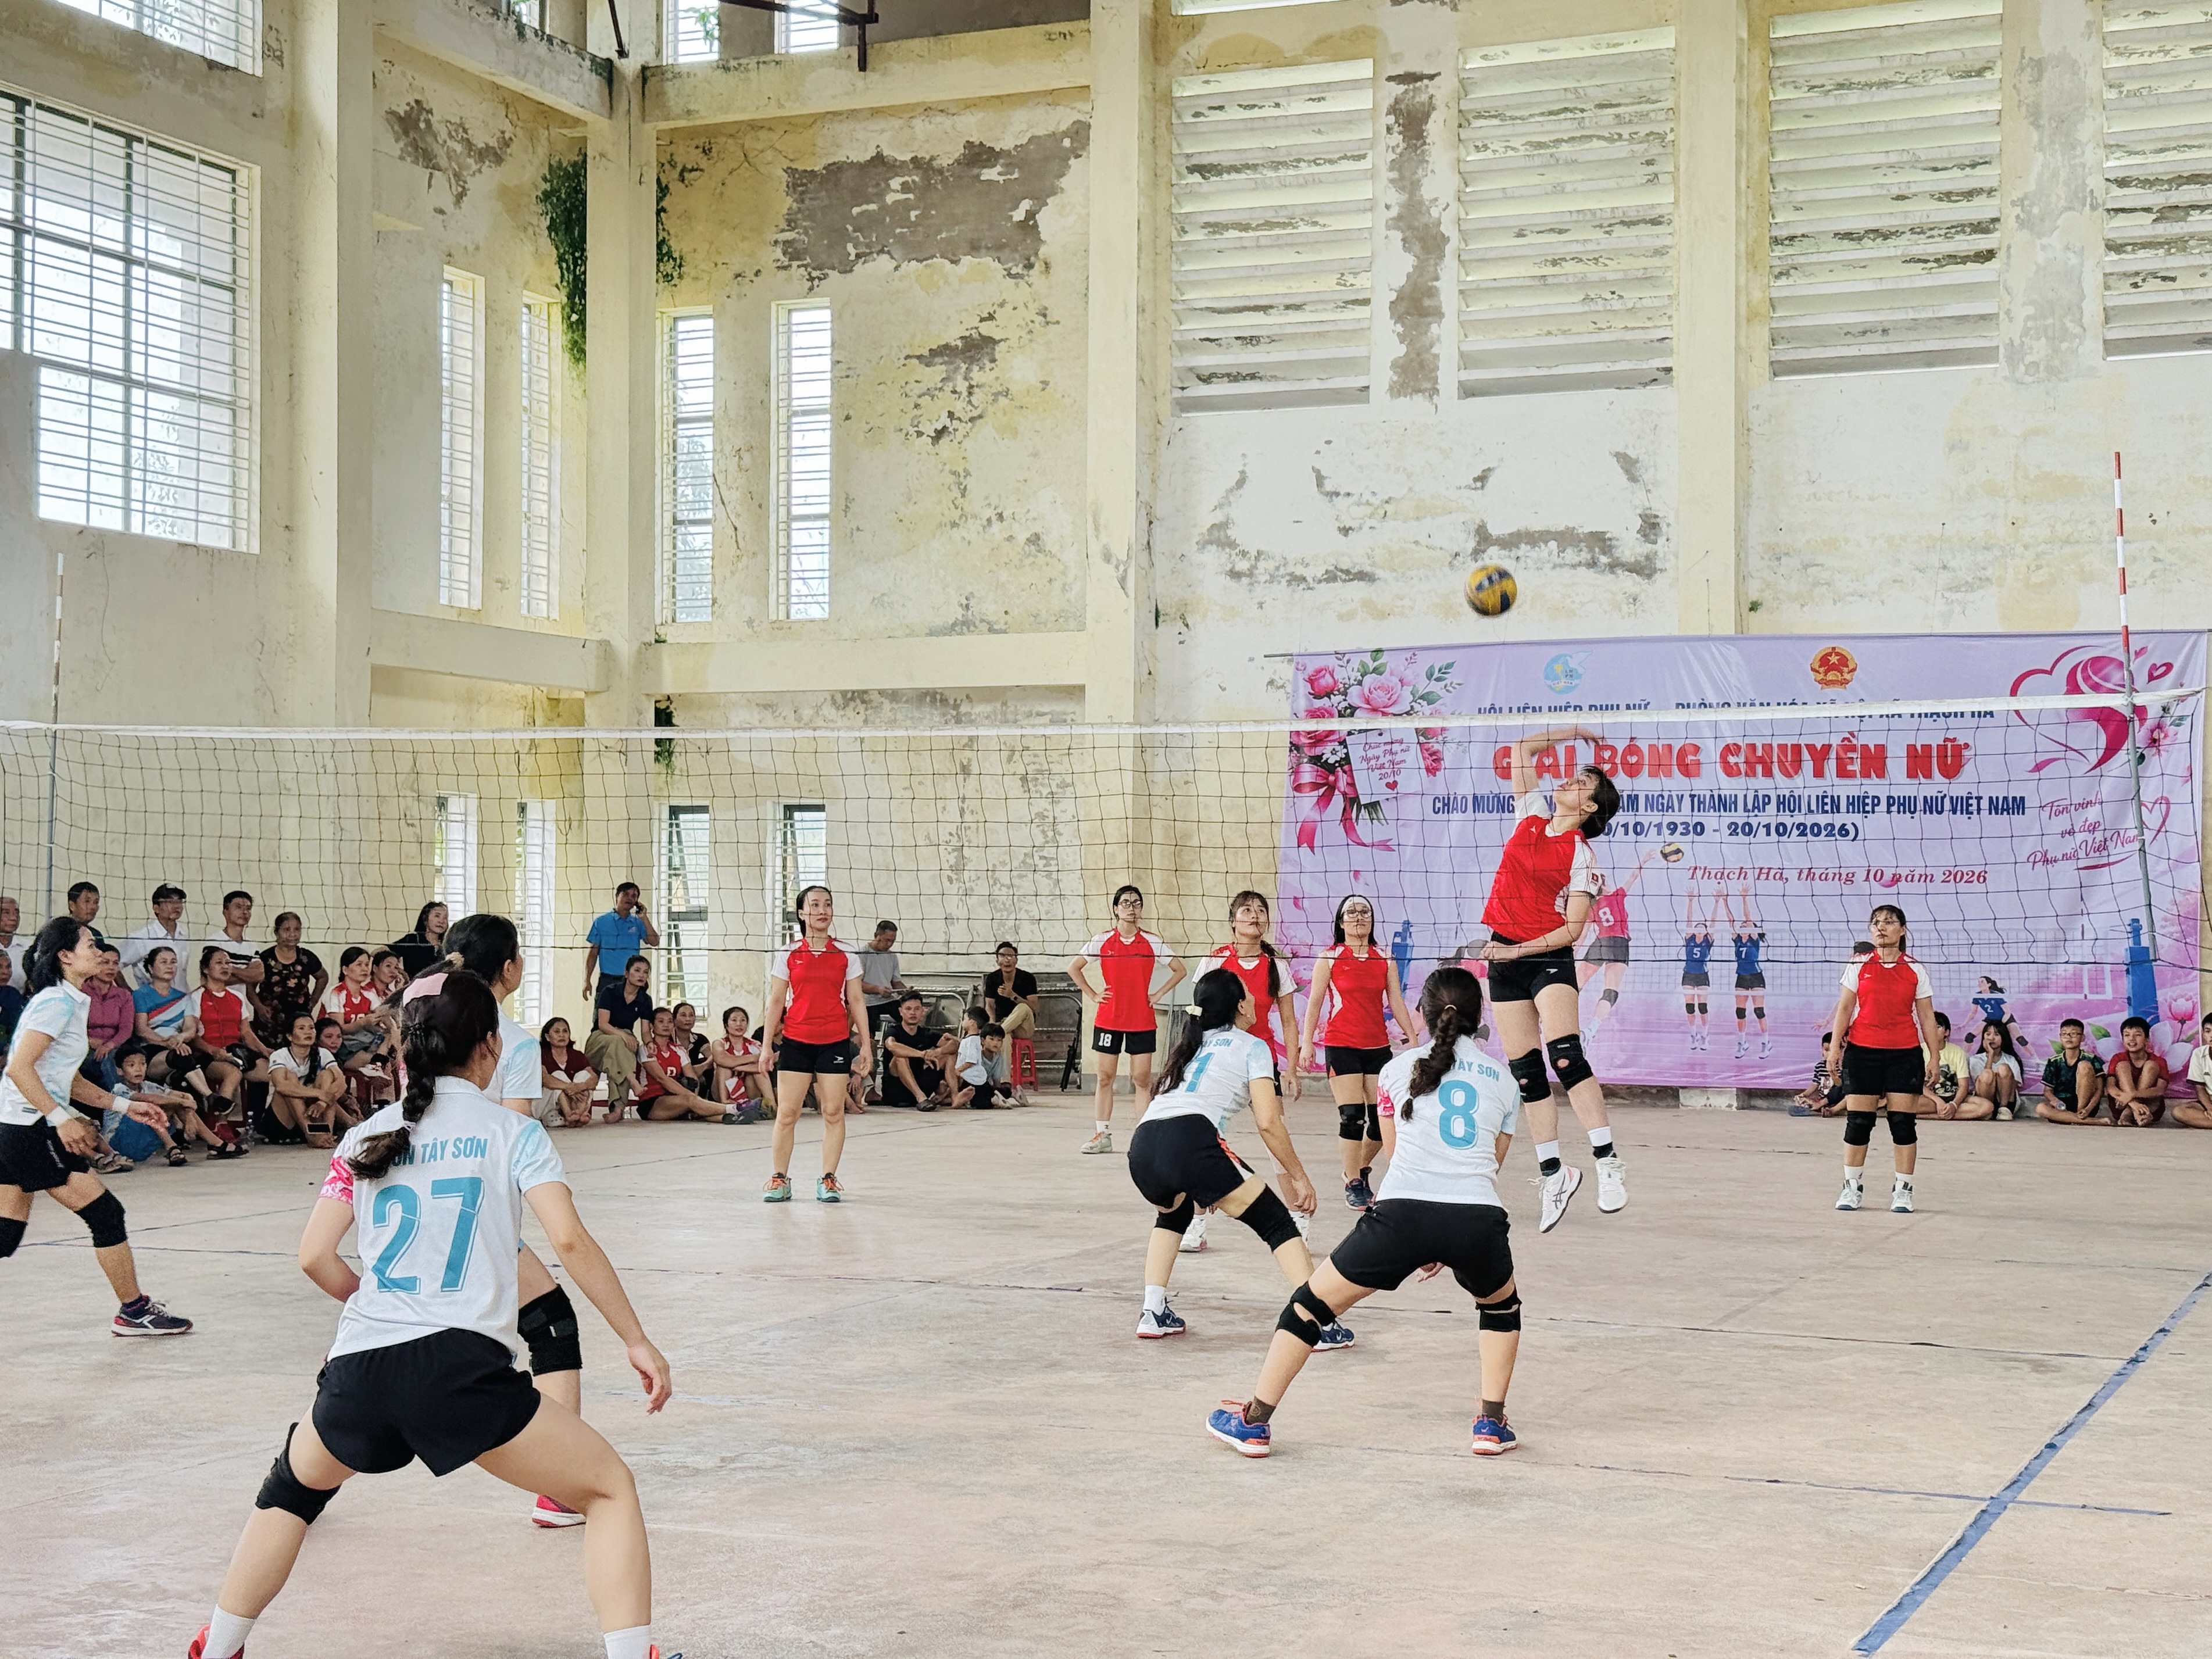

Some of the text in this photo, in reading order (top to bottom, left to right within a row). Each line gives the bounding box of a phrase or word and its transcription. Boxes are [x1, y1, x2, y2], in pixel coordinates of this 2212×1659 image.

[1593, 736, 1701, 778] BÓNG
[1719, 731, 1887, 778] CHUYỀN
[1906, 736, 1970, 780] NỮ
[1378, 769, 1401, 781] 20/10
[1472, 790, 1515, 814] MỪNG
[1617, 789, 2026, 820] ĂM NGÀY THÀNH LẬP HỘI LIÊN HIỆP PHỤ NỮ VIỆT NAM
[2041, 791, 2102, 820] Tôn vinh
[1603, 821, 1706, 838] 0/10/1930
[1727, 821, 1859, 842] 20/10/2026)
[2079, 817, 2102, 835] đẹp
[2027, 849, 2059, 870] Phụ
[2079, 836, 2109, 856] Việt
[1688, 866, 1749, 885] Thạch
[1797, 867, 1857, 885] tháng
[1861, 868, 1885, 882] 10
[1890, 869, 1935, 883] năm
[1941, 869, 1989, 884] 2026
[1599, 907, 1615, 927] 8
[1693, 947, 1701, 959] 5
[1739, 947, 1748, 959] 7
[1984, 1004, 1993, 1013] 2
[1098, 1032, 1112, 1047] 18
[1185, 1052, 1216, 1093] 1
[1477, 1063, 1500, 1082] SƠN
[1438, 1079, 1480, 1150] 8
[421, 1137, 449, 1164] TÂY
[452, 1135, 488, 1159] SƠN
[371, 1177, 485, 1295] 27
